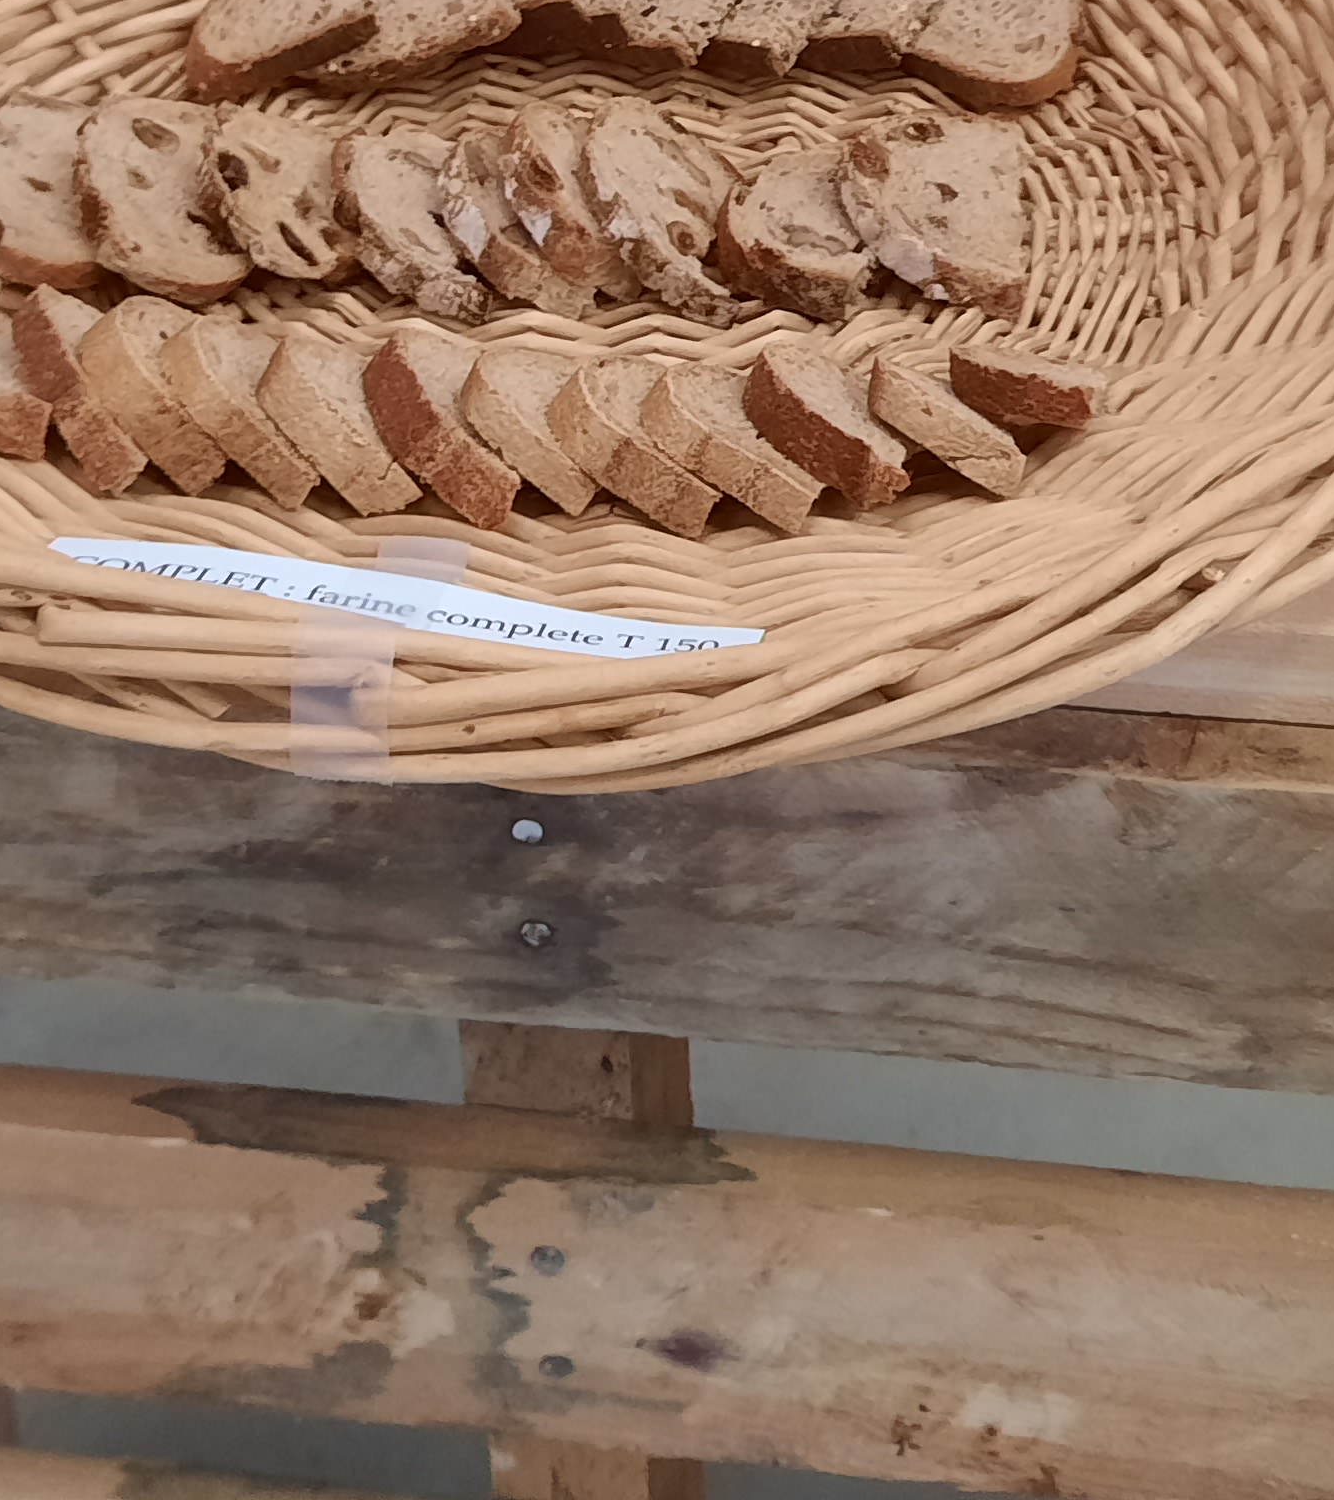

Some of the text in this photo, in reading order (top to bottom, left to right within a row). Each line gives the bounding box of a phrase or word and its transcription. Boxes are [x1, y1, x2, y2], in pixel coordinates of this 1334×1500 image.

[303, 584, 418, 617] farine
[617, 633, 644, 649] T
[655, 637, 719, 653] 150
